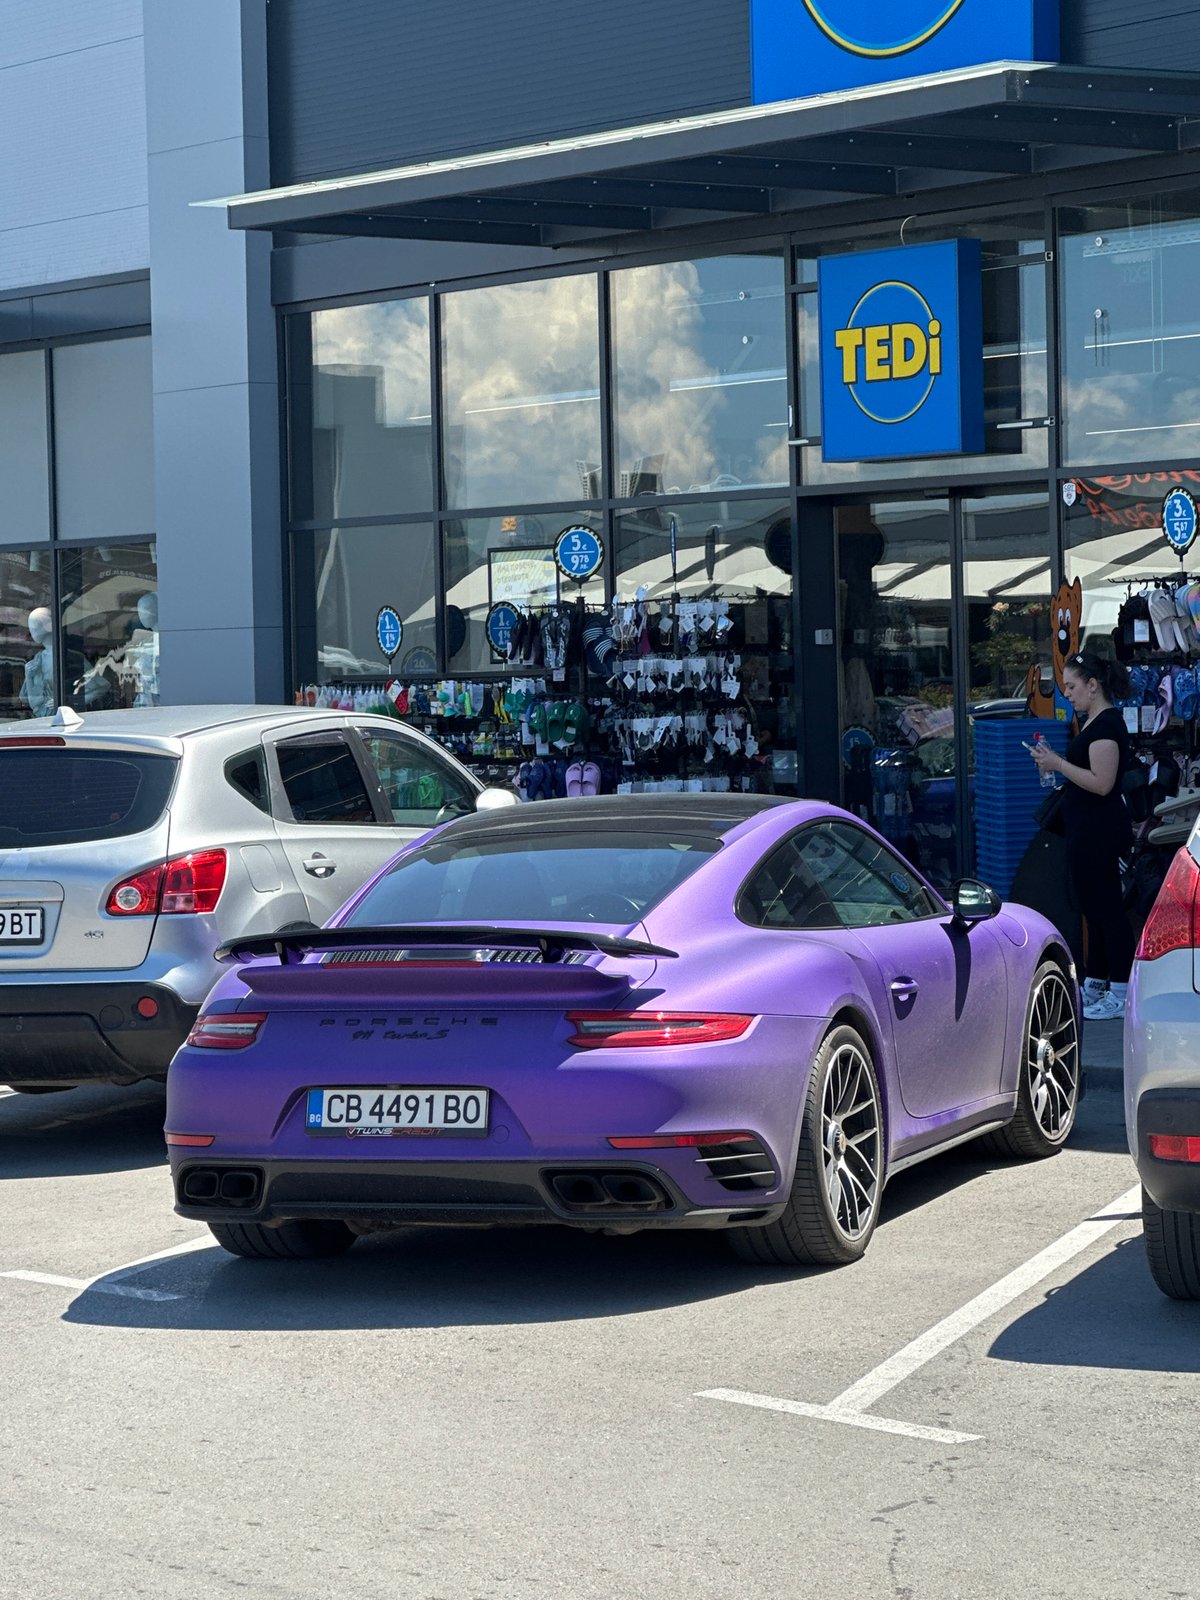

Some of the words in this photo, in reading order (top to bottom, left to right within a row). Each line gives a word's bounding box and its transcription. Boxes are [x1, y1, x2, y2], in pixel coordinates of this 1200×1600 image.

[834, 318, 942, 385] TEDi
[10, 913, 37, 935] BT
[319, 1017, 499, 1027] PORSCHE
[352, 1030, 374, 1041] 911
[327, 1094, 362, 1124] CB
[369, 1094, 435, 1124] 4491
[309, 1114, 321, 1123] BG
